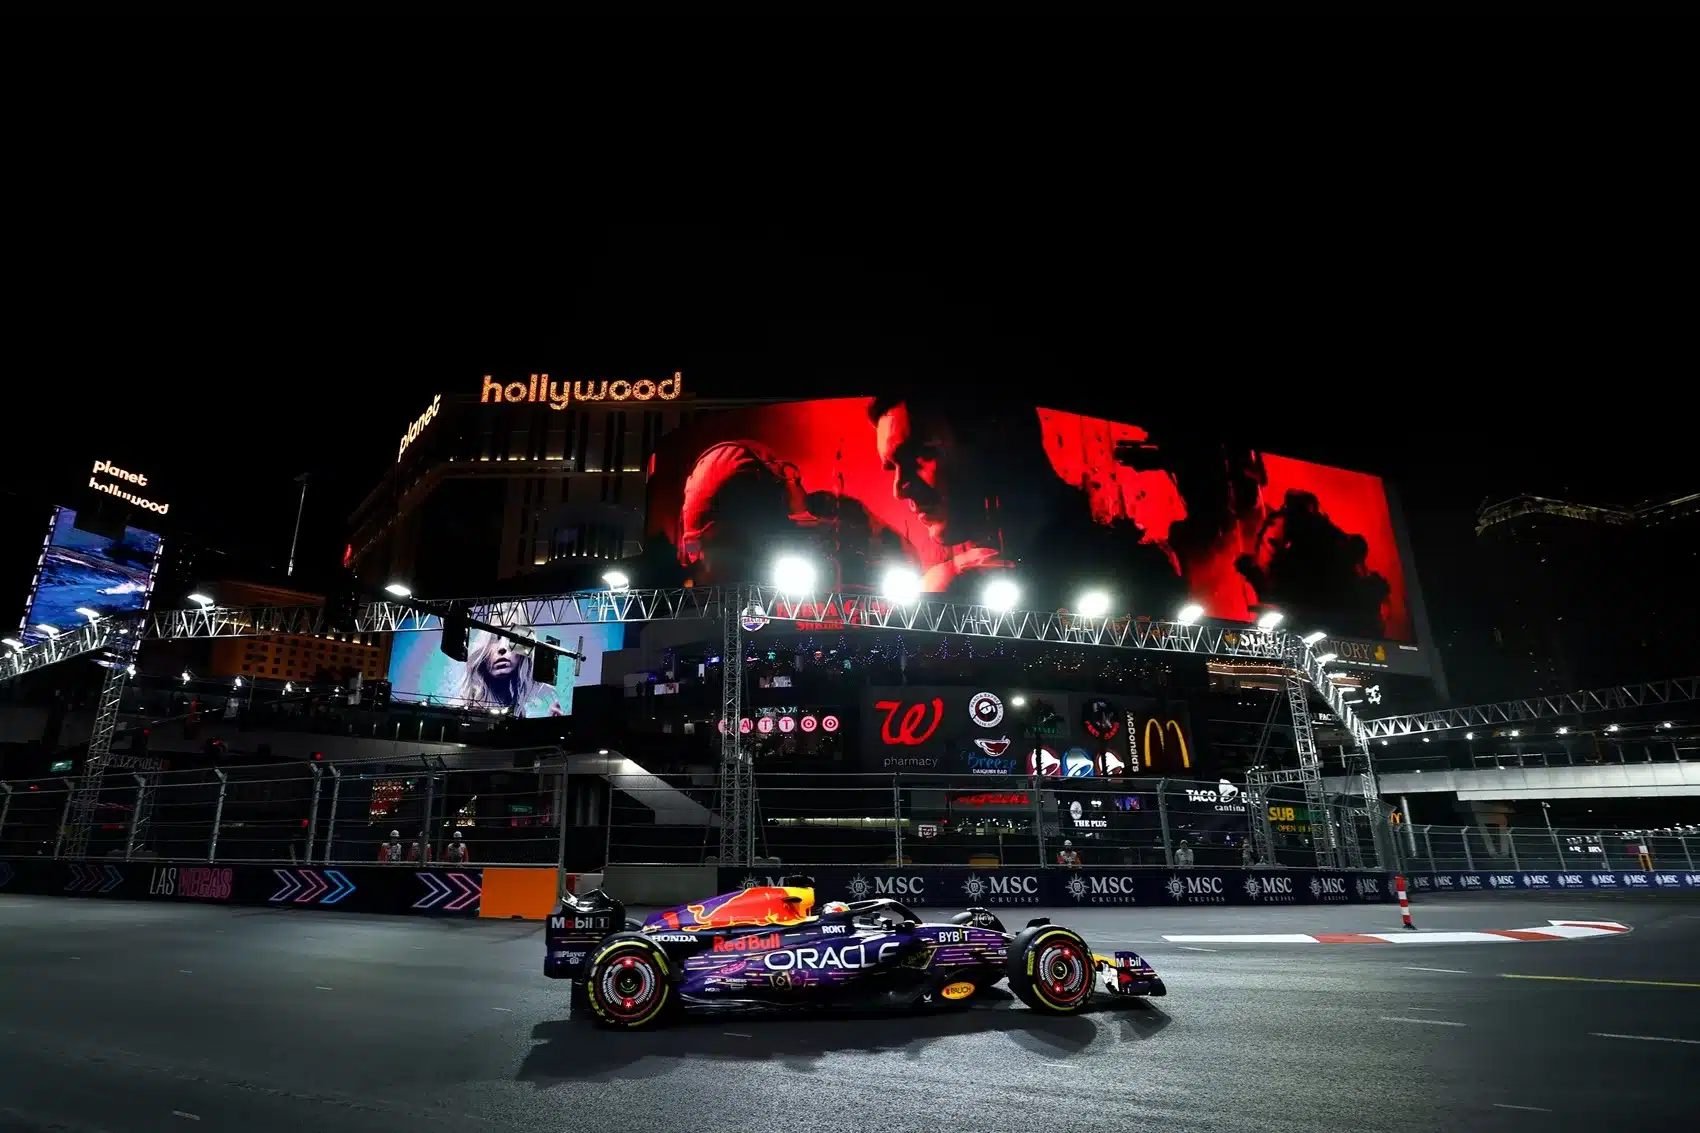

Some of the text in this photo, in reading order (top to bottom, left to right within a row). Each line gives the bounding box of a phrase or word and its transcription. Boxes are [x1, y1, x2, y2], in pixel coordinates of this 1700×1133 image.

[481, 371, 682, 410] hollywood
[397, 393, 441, 463] planet
[92, 460, 148, 487] planet
[884, 757, 938, 767] pharmacy
[1186, 789, 1217, 802] TACO
[1214, 803, 1246, 812] cantina
[1073, 820, 1088, 828] THE
[150, 867, 177, 895] LAS
[874, 876, 924, 894] MSC
[989, 876, 1038, 894] MSC
[1090, 876, 1134, 894] MSC
[1186, 877, 1223, 894] MSC
[1261, 877, 1293, 894] MSC
[1321, 877, 1346, 893] MSC
[1363, 878, 1380, 893] MSC
[551, 916, 593, 929] Mobil
[822, 925, 847, 934] ROKT
[651, 934, 698, 943] HONDA
[713, 933, 780, 953] Red Bull
[938, 929, 970, 943] BYBIT
[764, 942, 900, 970] ORACLE
[1116, 956, 1142, 968] Mobil
[950, 985, 972, 994] RAUCH
